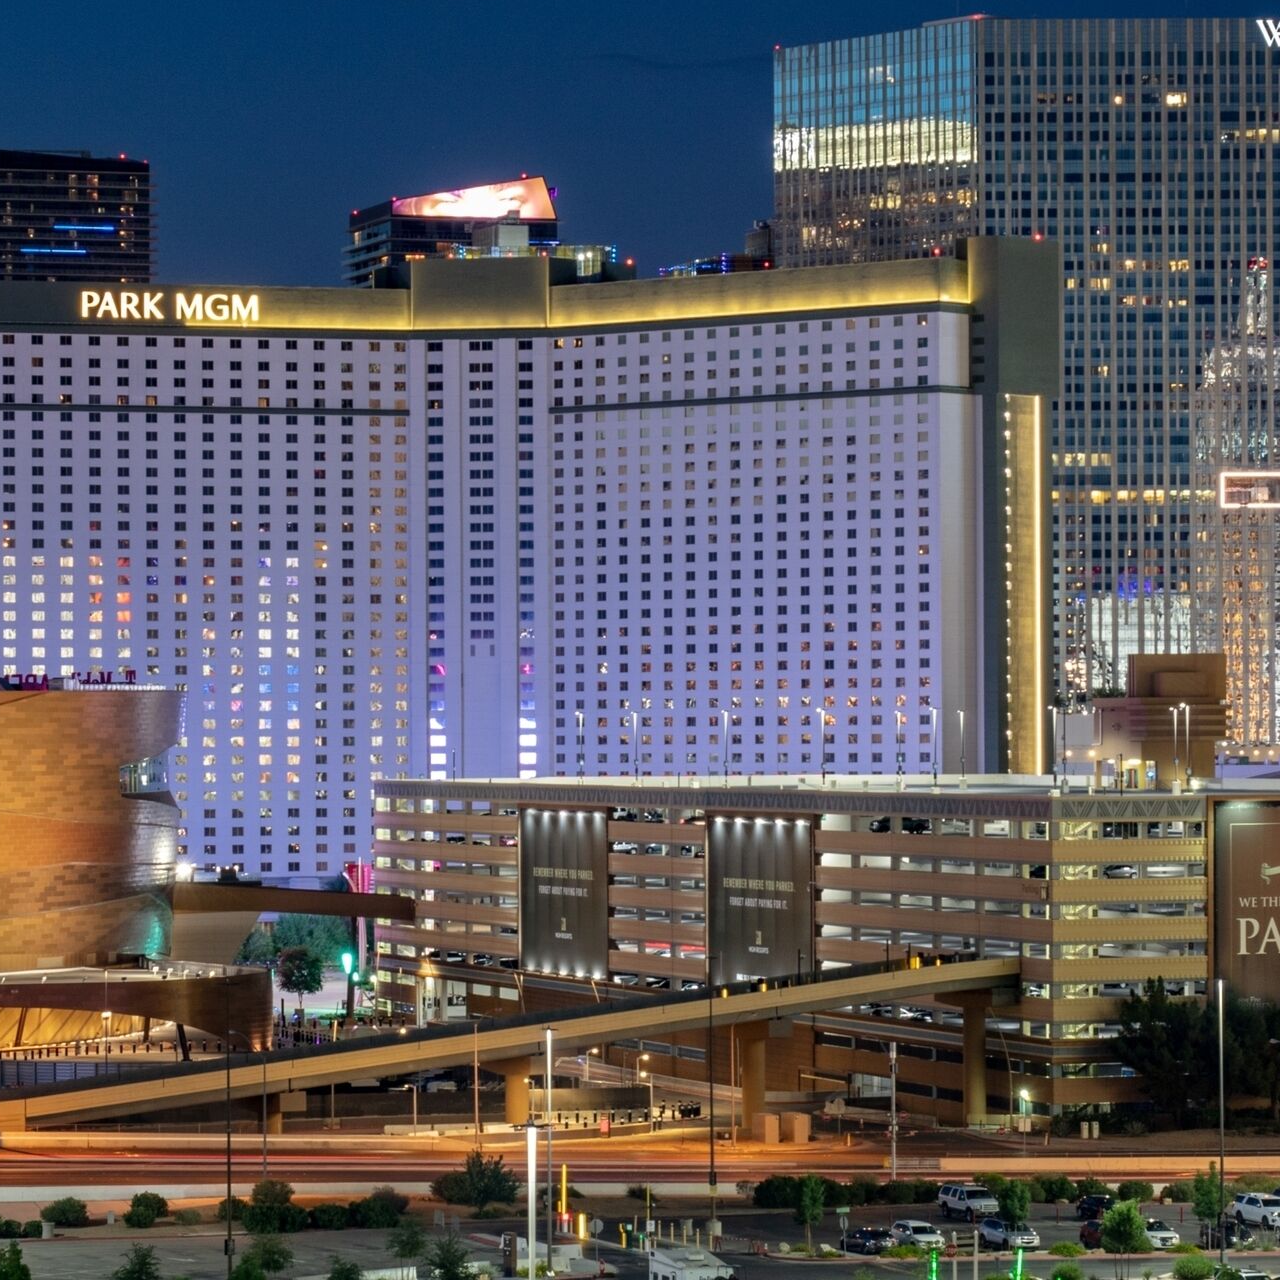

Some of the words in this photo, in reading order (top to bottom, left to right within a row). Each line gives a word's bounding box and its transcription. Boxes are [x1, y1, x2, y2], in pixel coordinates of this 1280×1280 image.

[80, 290, 164, 320] PARK
[175, 293, 259, 322] MGM
[1239, 897, 1257, 908] WE
